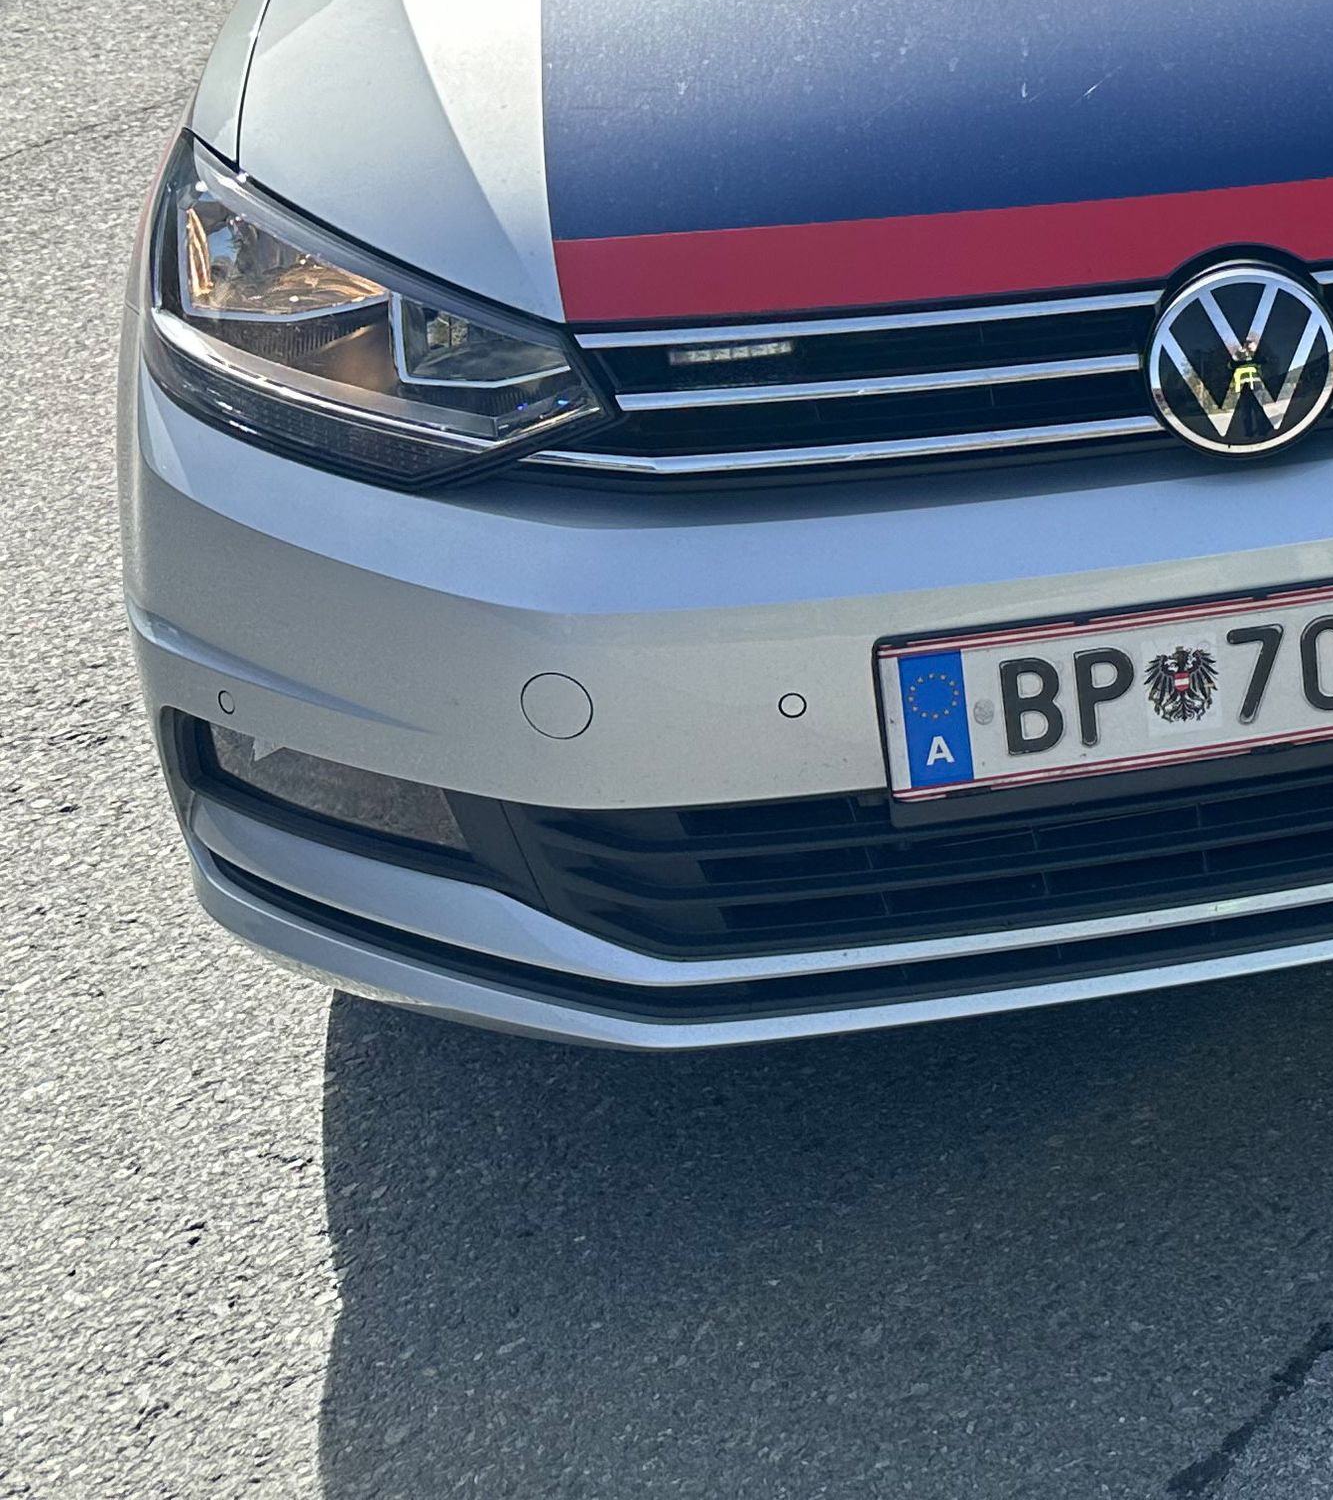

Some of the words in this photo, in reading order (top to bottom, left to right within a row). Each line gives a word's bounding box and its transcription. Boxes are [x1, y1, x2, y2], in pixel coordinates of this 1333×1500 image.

[1157, 276, 1333, 442] VW
[926, 735, 956, 767] A
[999, 646, 1135, 757] BP
